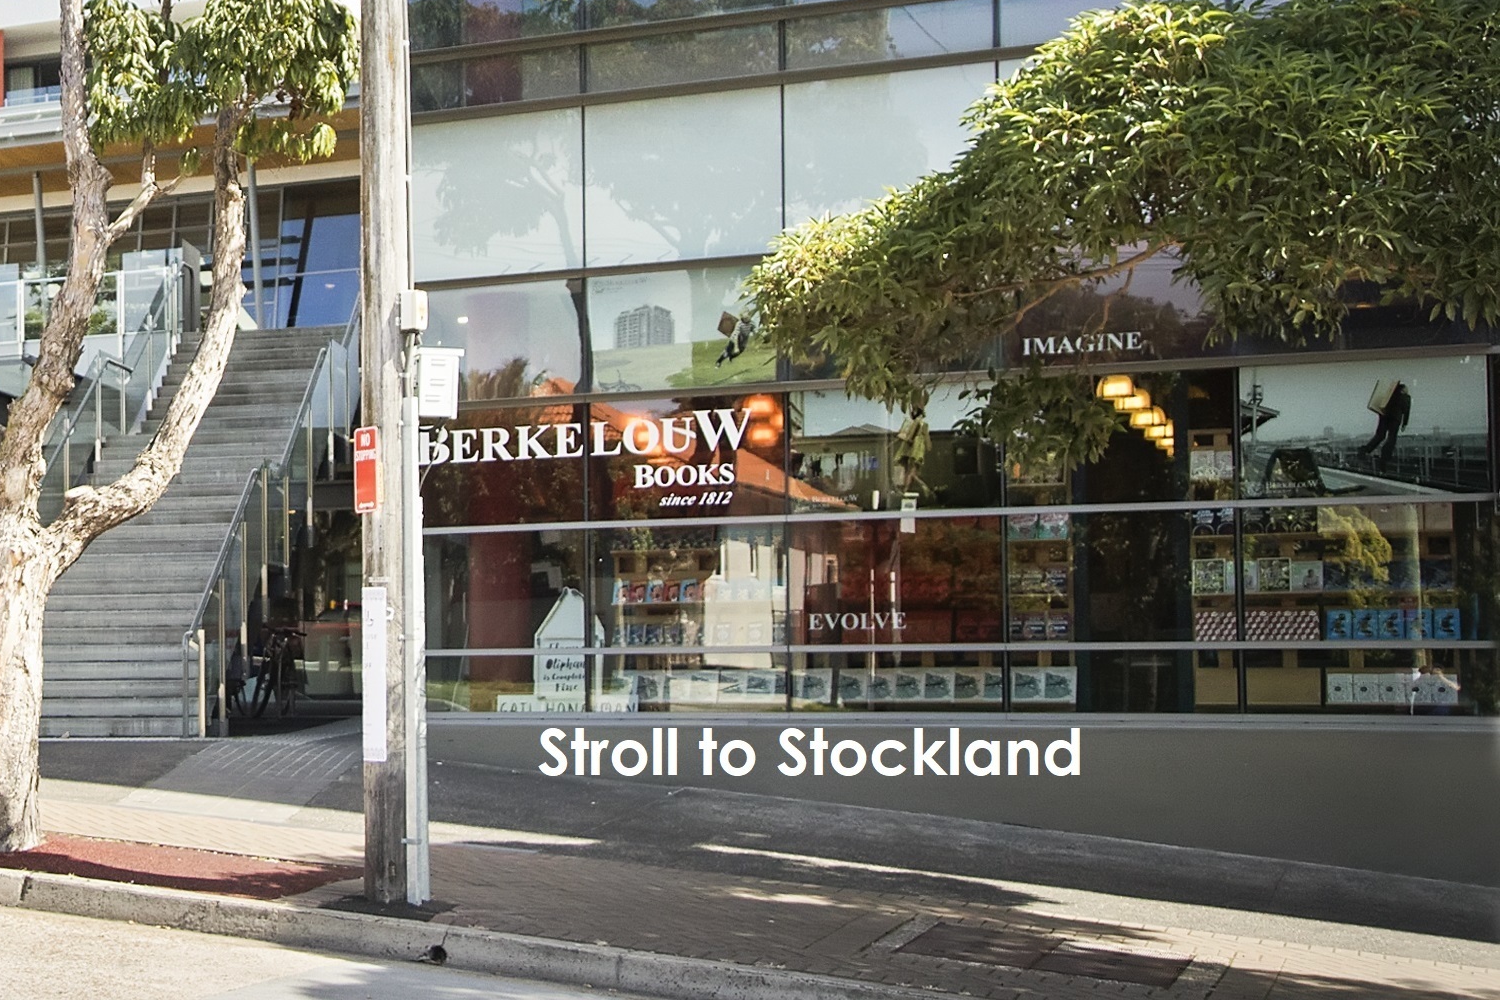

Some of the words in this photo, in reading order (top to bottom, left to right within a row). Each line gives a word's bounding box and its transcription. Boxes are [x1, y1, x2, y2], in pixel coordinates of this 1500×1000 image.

[1022, 332, 1142, 356] IMAGINE
[360, 433, 371, 447] NO
[419, 408, 752, 466] BERKELOUW
[633, 463, 735, 488] BOOKS
[659, 493, 697, 507] since
[698, 491, 733, 505] 1812
[809, 611, 907, 631] EVOLVE
